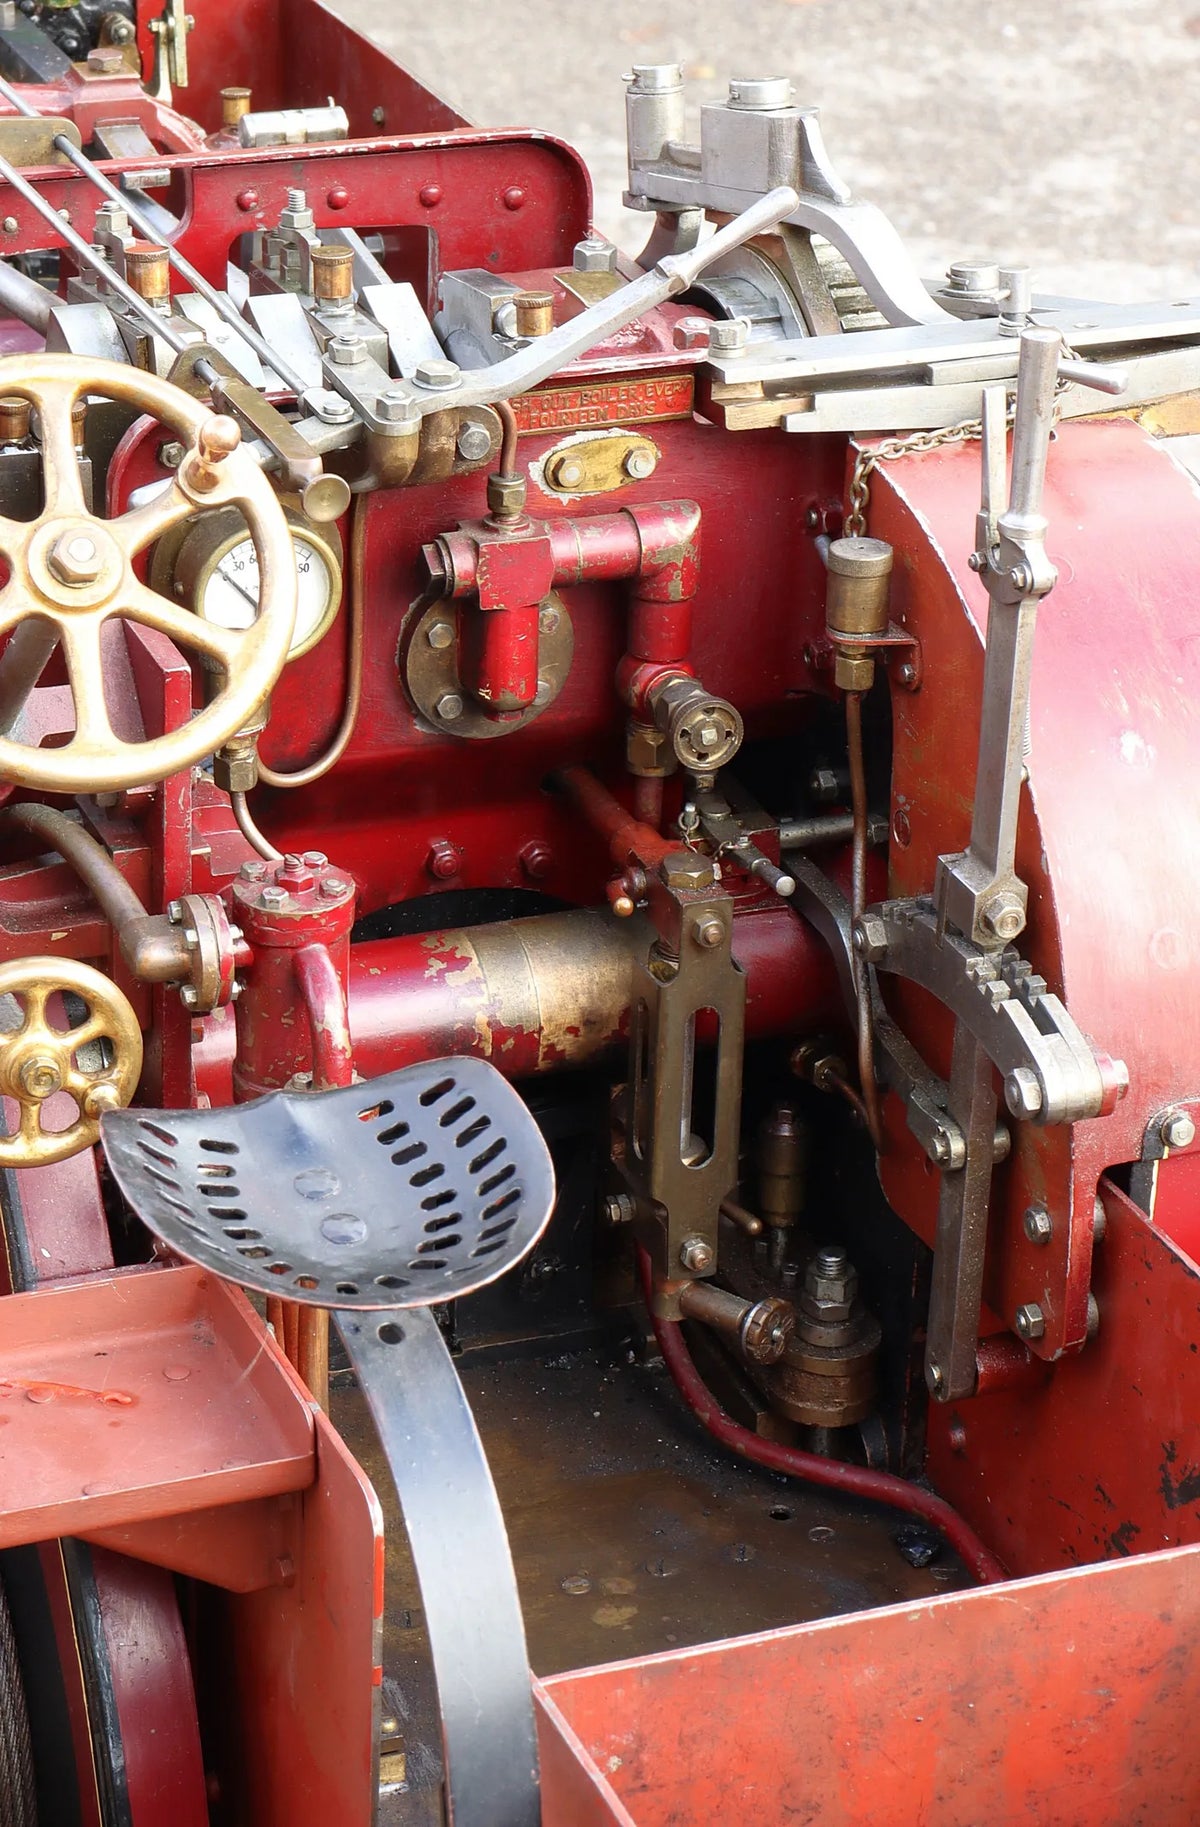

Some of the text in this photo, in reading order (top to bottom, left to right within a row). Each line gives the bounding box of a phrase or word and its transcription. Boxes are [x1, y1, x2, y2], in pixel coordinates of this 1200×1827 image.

[511, 397, 530, 410] SH
[542, 392, 573, 410] OUT
[646, 380, 691, 397] EVERY
[530, 400, 656, 430] FOURTEEN DAYS
[233, 560, 245, 572] 30
